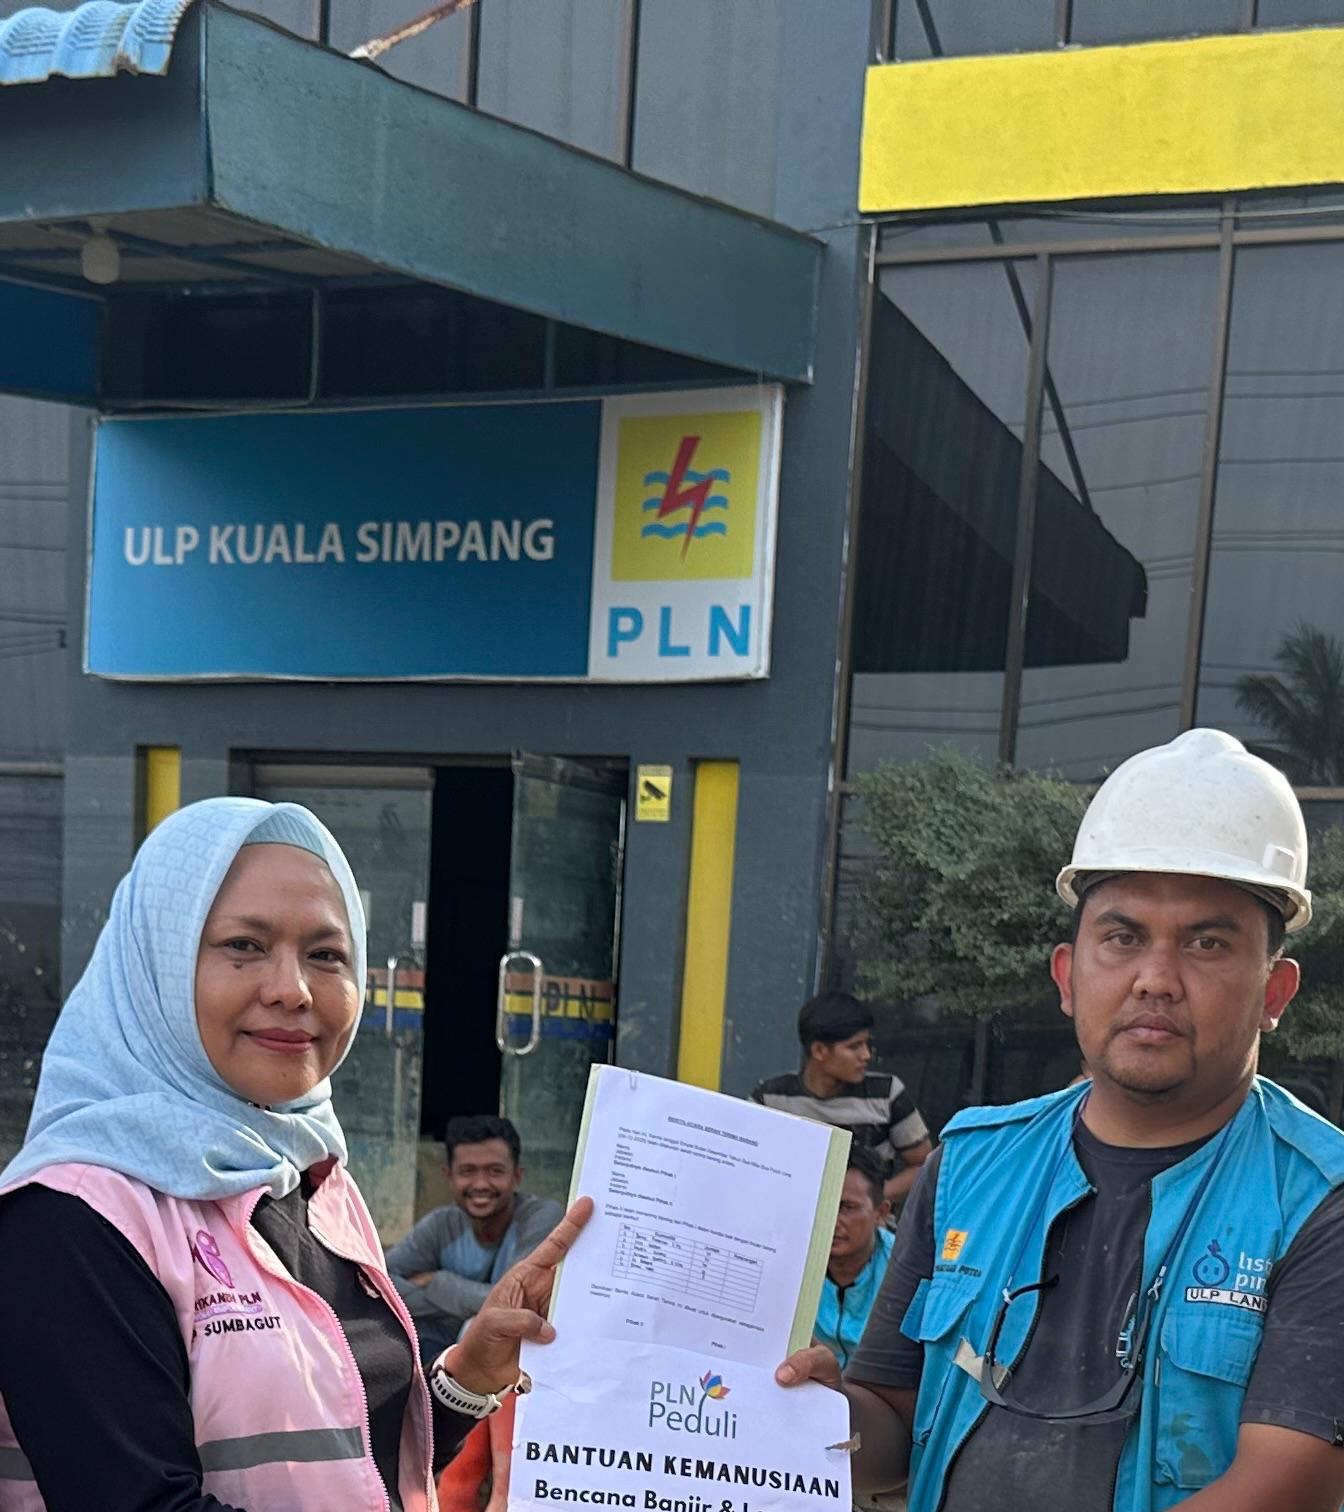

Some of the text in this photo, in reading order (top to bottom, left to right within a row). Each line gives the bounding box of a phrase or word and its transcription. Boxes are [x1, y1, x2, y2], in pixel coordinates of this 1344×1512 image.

[123, 518, 556, 565] ULP KUALA SIMPANG
[607, 605, 752, 657] PLN
[238, 1292, 261, 1304] PLN
[1190, 1289, 1220, 1300] ULP
[204, 1316, 281, 1336] SUMBAGUT
[650, 1381, 695, 1406] PLN
[648, 1399, 737, 1439] Peduli
[526, 1442, 840, 1498] BANTUAN KEMANUSIAAN
[534, 1480, 636, 1507] Bencana
